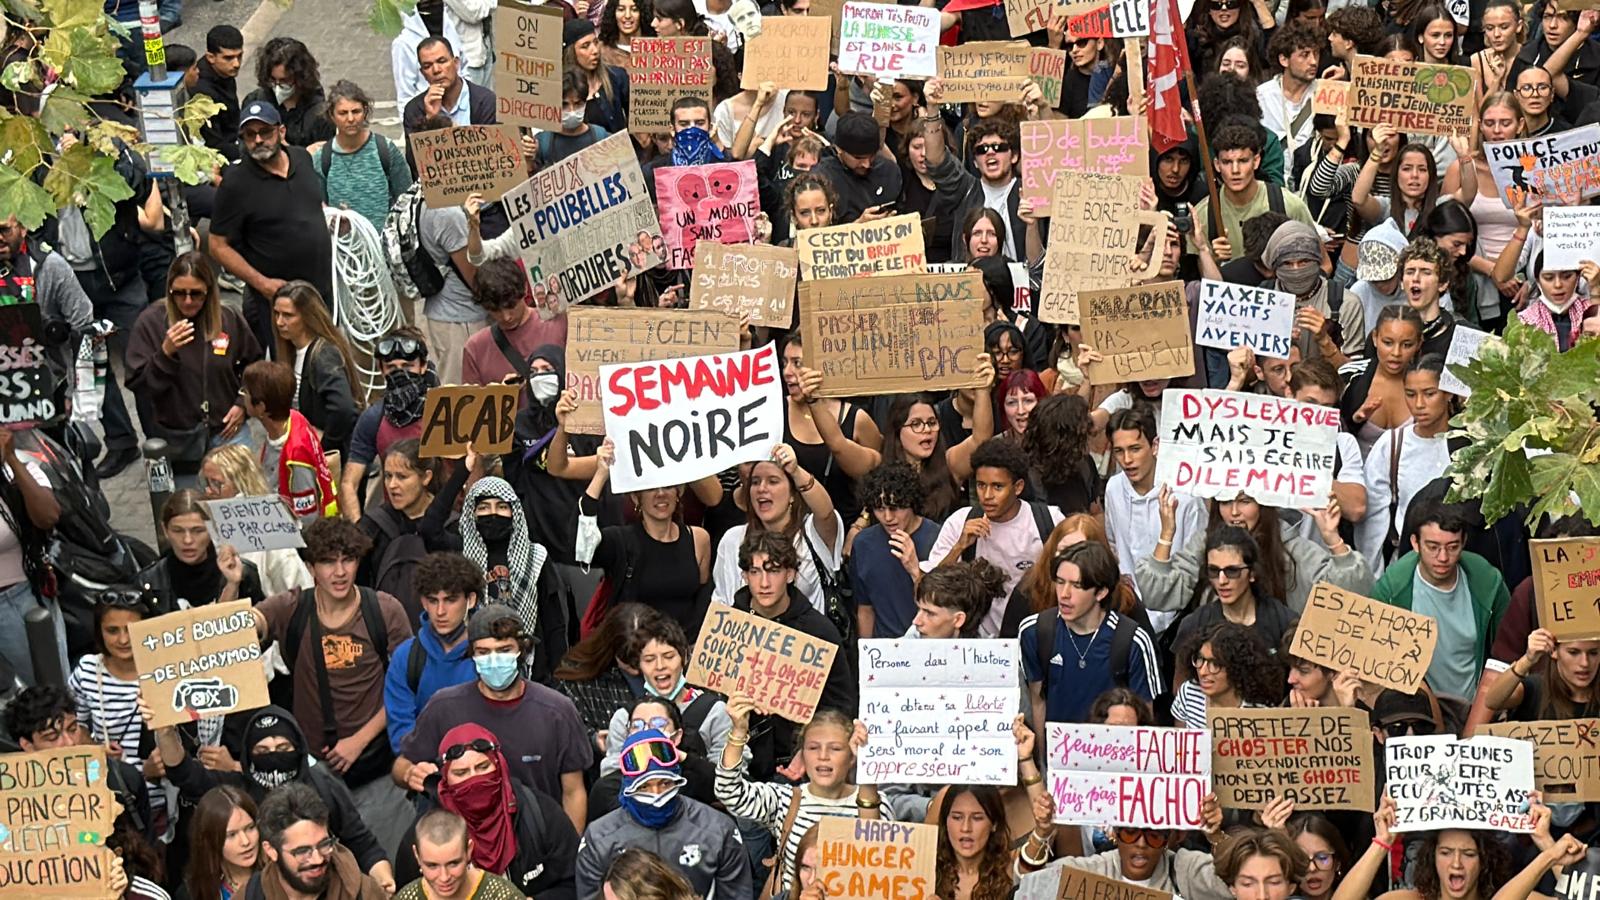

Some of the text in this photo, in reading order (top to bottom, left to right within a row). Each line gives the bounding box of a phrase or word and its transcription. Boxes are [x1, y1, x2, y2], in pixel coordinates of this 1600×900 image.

[517, 16, 538, 33] ON
[862, 22, 916, 43] JEUNESSE
[515, 34, 538, 50] SE
[683, 40, 706, 53] EST
[845, 41, 927, 54] EST DANS LA
[500, 51, 555, 78] TRUMP
[630, 54, 711, 71] UN DROIT PAS
[856, 53, 905, 72] RUE
[943, 51, 1027, 68] PLUS DE POULET
[1358, 61, 1418, 77] TRÈFLE DE
[516, 78, 540, 96] DE
[630, 72, 647, 85] UN
[1355, 77, 1430, 95] PLAISANTERIE
[498, 97, 562, 124] DIRECTION
[1358, 89, 1465, 117] PAS DE JEUNESSE
[1438, 117, 1471, 125] COMME
[414, 127, 488, 150] PAS DE FRAIS
[1056, 122, 1081, 149] de
[1060, 150, 1083, 167] des
[1492, 138, 1559, 161] POLICE
[504, 157, 584, 222] LES FEUX
[1056, 178, 1082, 198] PLUS
[676, 201, 756, 228] UN MONDE
[1058, 200, 1123, 223] DE BOIRE
[519, 222, 538, 250] de
[690, 224, 723, 241] SANS
[808, 222, 912, 247] C'EST NOUS ON
[1051, 222, 1130, 249] POUR FLOU
[704, 253, 769, 273] 1 PROF
[812, 243, 900, 265] FAIT DU BRUIT
[1049, 252, 1129, 276] & DE FUMER
[559, 243, 631, 303] ORDURES
[812, 256, 903, 280] PENDANT QUE LE
[914, 280, 973, 303] NOUS
[1045, 273, 1073, 292] POUR
[1205, 283, 1276, 306] TAXER
[1203, 300, 1272, 321] YACHTS
[817, 312, 880, 336] PASSER
[1094, 329, 1130, 351] PAS
[1201, 327, 1291, 357] AVENIRS
[577, 349, 626, 363] VISENT
[919, 345, 974, 381] BAC
[608, 347, 775, 417] SEMAINE
[421, 395, 515, 446] ACAB
[1182, 393, 1341, 427] DYSLEXIQUE
[629, 396, 770, 478] NOIRE
[1171, 422, 1296, 449] MAIS JE
[1202, 447, 1334, 471] SAIS ECRIRE
[1176, 461, 1316, 496] DILEMME
[219, 500, 283, 520] BIENTÔT
[239, 520, 265, 536] PAR
[248, 535, 265, 550] ?!
[1543, 547, 1569, 563] LA
[1313, 587, 1433, 639] ES LA HORA
[1553, 601, 1576, 622] LE
[142, 610, 256, 651] + DE BOULOTS
[710, 610, 829, 669] JOURNÉE DE
[1334, 619, 1400, 650] DE LA
[703, 635, 826, 691] COURS + LONGUE
[924, 647, 1012, 667] dans l'histoire
[1300, 629, 1420, 686] REVOLUCIÓN
[153, 663, 177, 684] DE
[698, 652, 799, 700] QUE LA BITE
[707, 671, 816, 720] DE BRIGITTE
[866, 693, 1007, 714] n'a obtenu sa liberté
[868, 719, 1014, 749] en faisant appel au
[1212, 716, 1353, 739] ARRETEZ DE
[865, 742, 1006, 758] sens moral de son
[1314, 736, 1353, 753] NOS
[1389, 743, 1513, 763] TROP JEUNES
[0, 754, 93, 790] BUDGET
[1236, 755, 1361, 769] REVENDICATIONS
[1388, 763, 1502, 781] POUR ETRE
[1214, 769, 1361, 786] MON EX ME GHOSTE
[1052, 776, 1118, 815] Mais pas
[1233, 787, 1351, 804] DEJA ASSEZ
[1474, 799, 1506, 814] POUR
[1419, 805, 1487, 823] GRANDS
[854, 819, 915, 844] HAPPY
[821, 840, 915, 869] HUNGER
[0, 855, 101, 888] DUCATION
[824, 871, 927, 900] GAMES
[1062, 873, 1087, 900] LA
